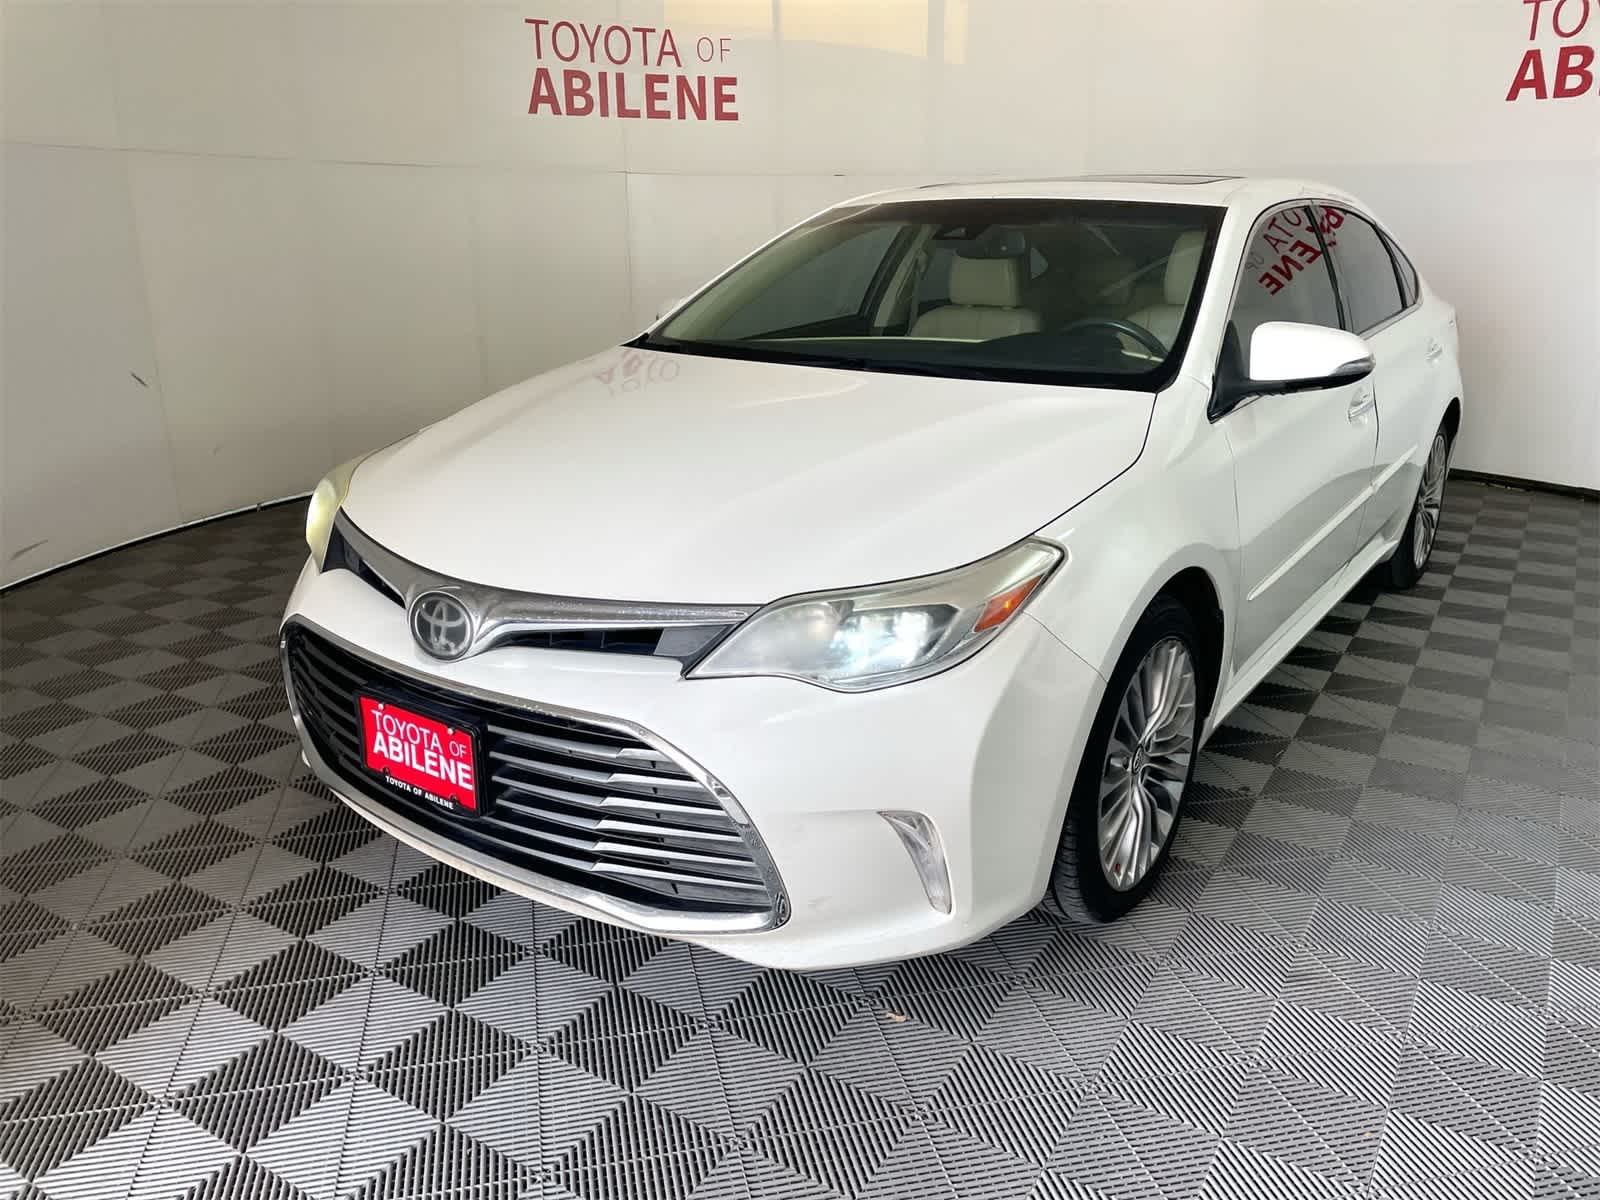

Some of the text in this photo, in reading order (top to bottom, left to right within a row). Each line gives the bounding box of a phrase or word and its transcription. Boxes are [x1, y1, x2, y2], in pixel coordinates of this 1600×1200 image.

[524, 18, 732, 67] TOYOTA OF
[1523, 0, 1600, 40] TO
[528, 67, 739, 121] ABILENE
[1505, 45, 1600, 101] AB
[371, 709, 467, 758] TOYOTA OF
[373, 731, 473, 791] ABILENE
[385, 775, 454, 810] TOYOTA OF ABILENE
